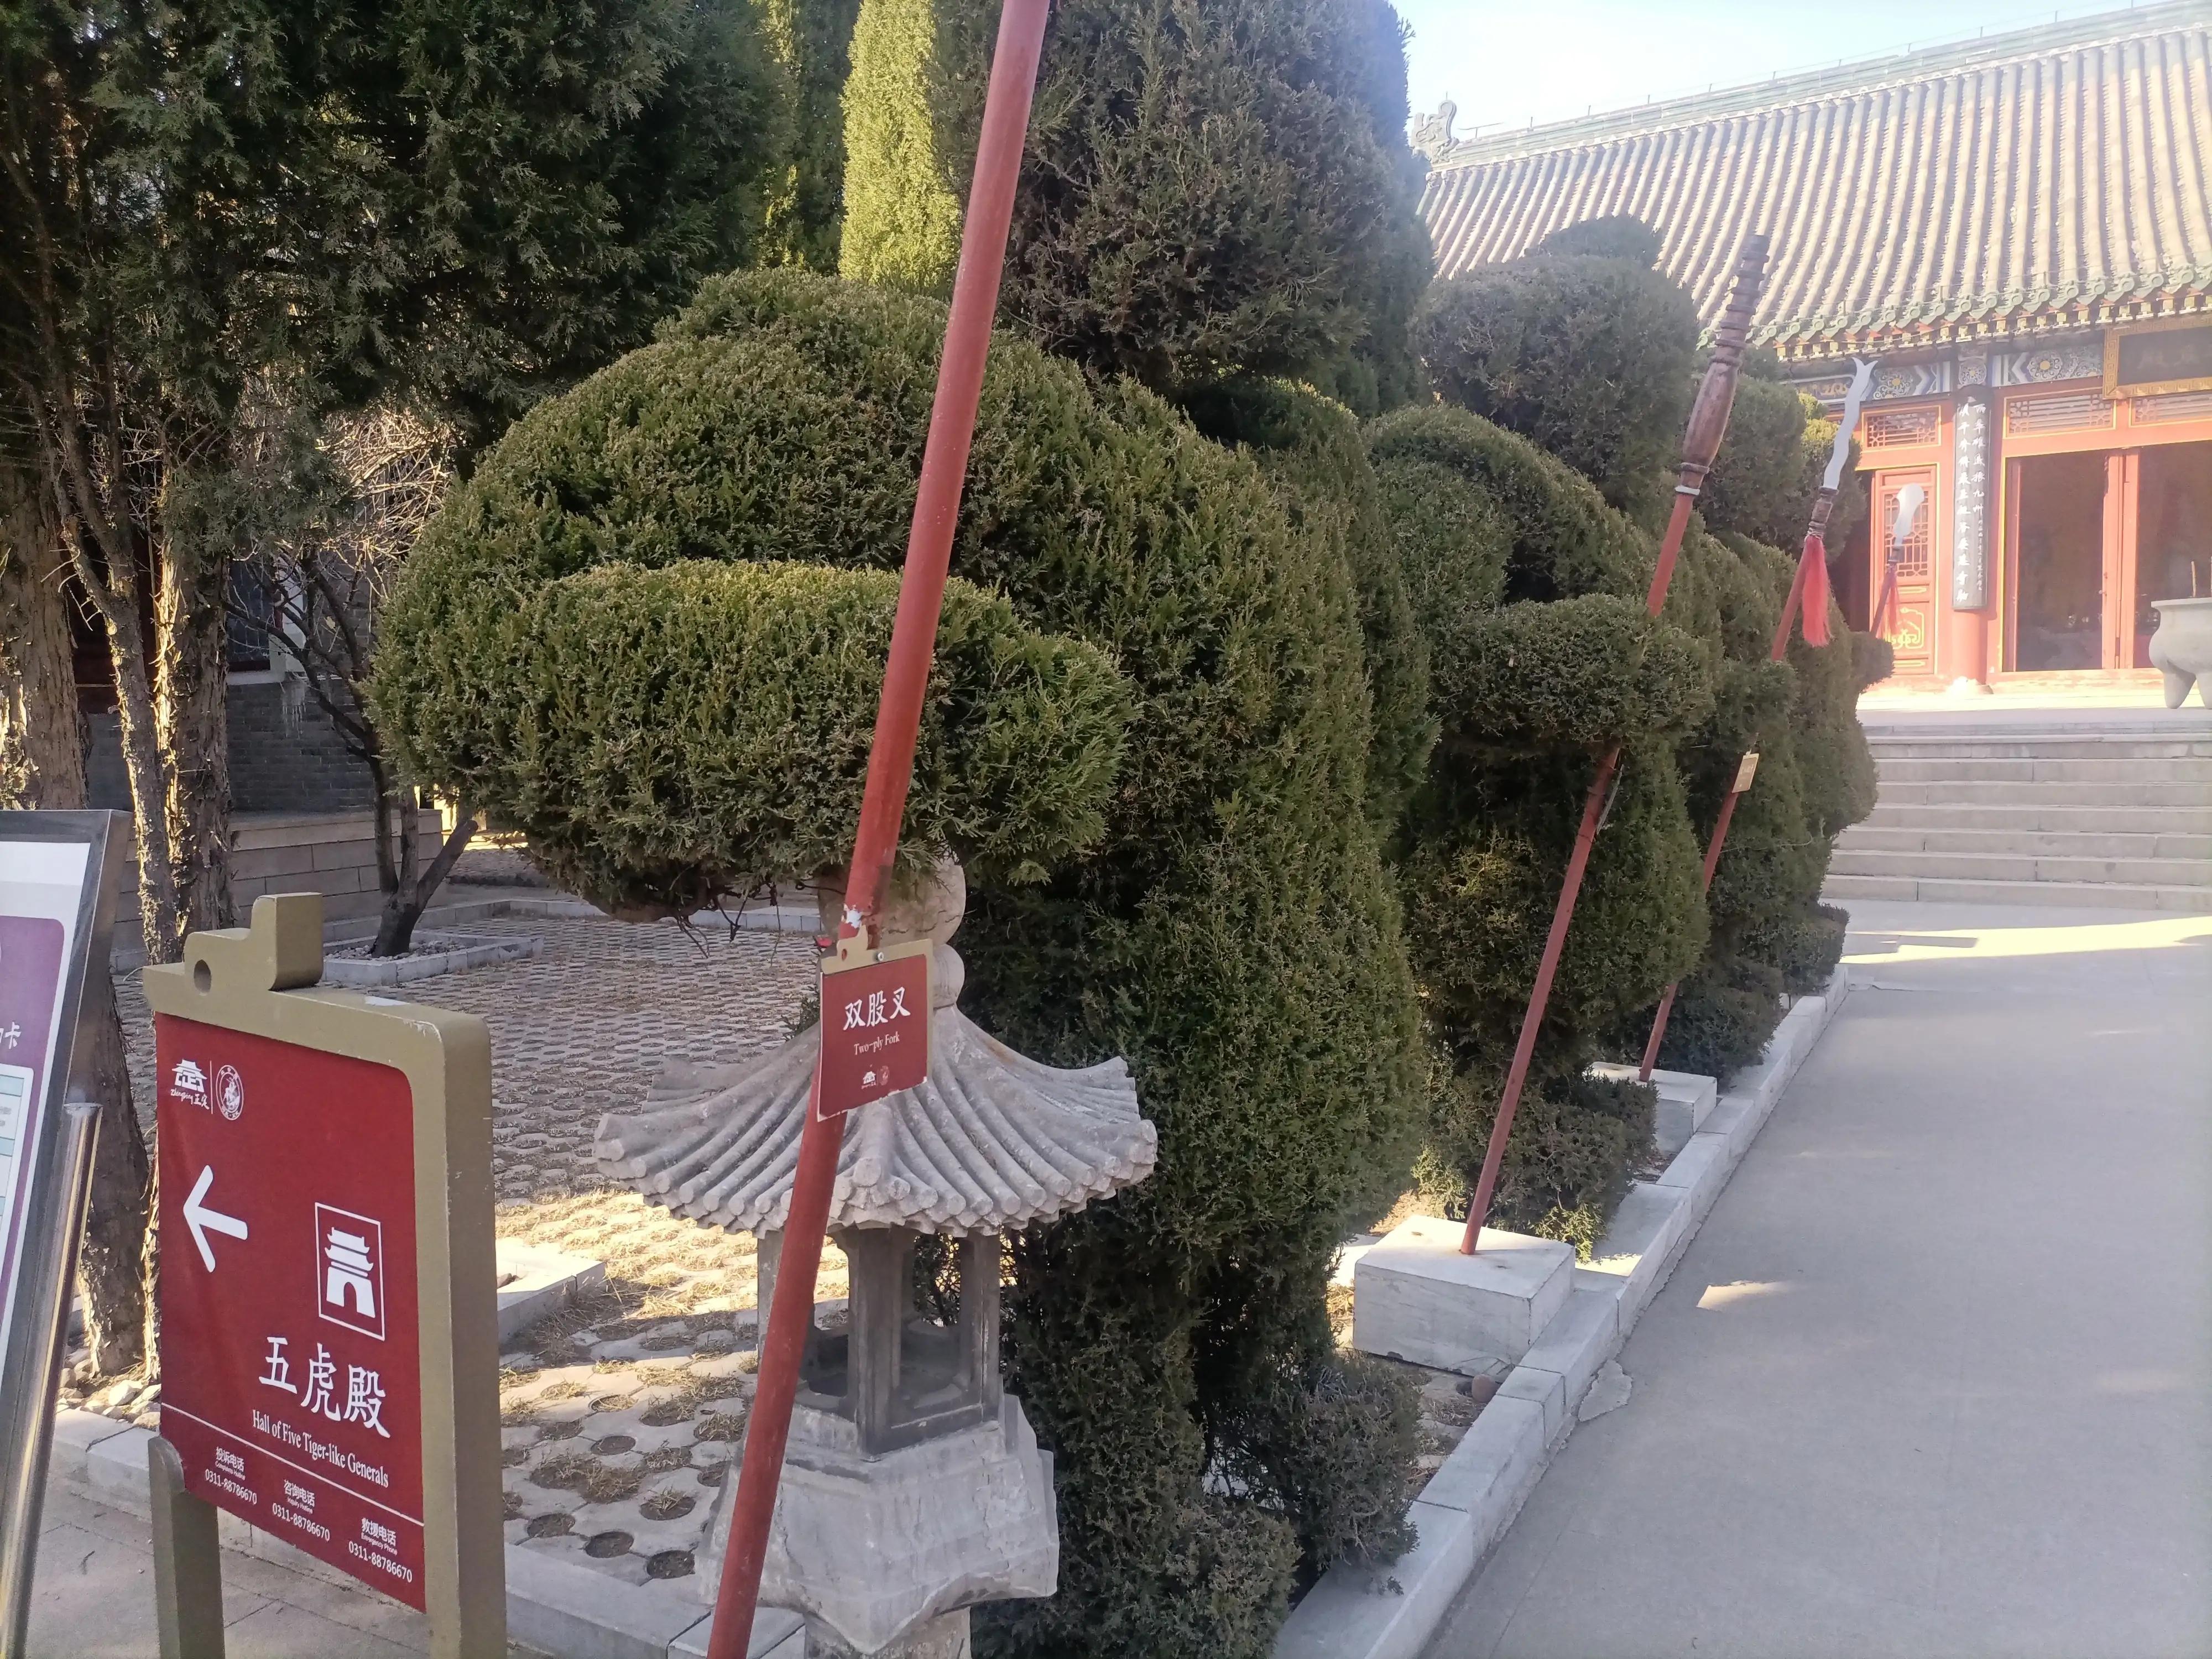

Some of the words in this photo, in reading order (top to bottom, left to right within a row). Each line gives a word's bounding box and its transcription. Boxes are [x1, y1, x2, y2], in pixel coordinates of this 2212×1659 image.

[842, 987, 911, 1031] 双股叉
[0, 1021, 22, 1050] 卡
[854, 1036, 884, 1056] Two-ply
[885, 1031, 900, 1046] Fork
[258, 1336, 391, 1438] 五虎殿
[215, 1446, 244, 1473] 投诉电话
[252, 1408, 271, 1434] Hall
[271, 1420, 283, 1439] of
[282, 1423, 301, 1449] Five
[302, 1431, 346, 1469] Tiger-like
[347, 1452, 389, 1489] Generals
[205, 1468, 257, 1505] 0311-88786670
[283, 1479, 315, 1507] 咨询电话
[272, 1503, 331, 1542] 0311-88786670
[361, 1517, 397, 1547] 救援电话
[348, 1541, 413, 1583] 0311-88786670
